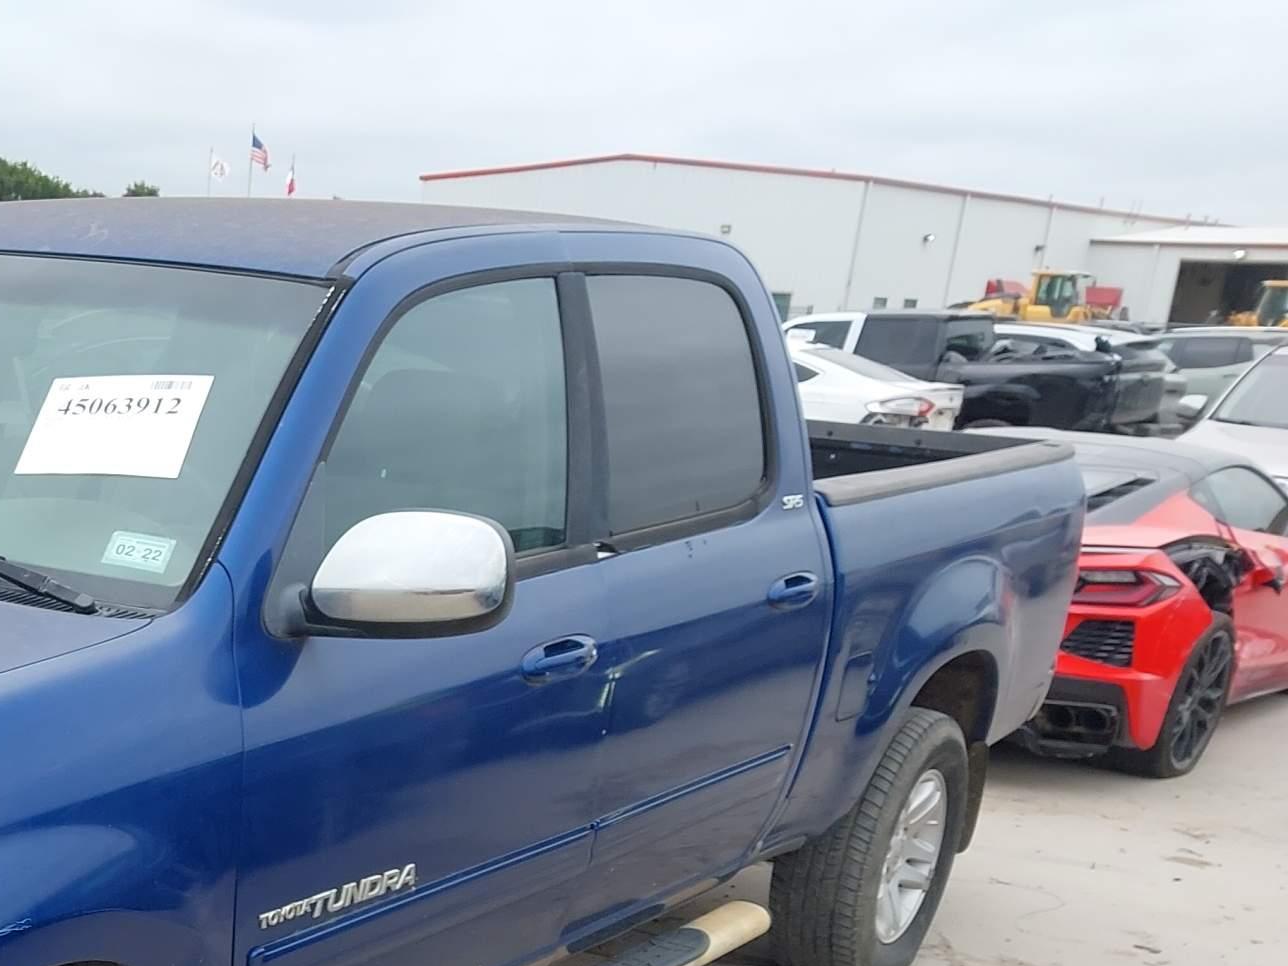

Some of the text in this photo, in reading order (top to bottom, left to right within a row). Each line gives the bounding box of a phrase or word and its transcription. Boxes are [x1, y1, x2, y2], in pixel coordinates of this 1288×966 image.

[57, 397, 182, 416] 45063912
[258, 863, 416, 929] TOYOTA TUNDRA
